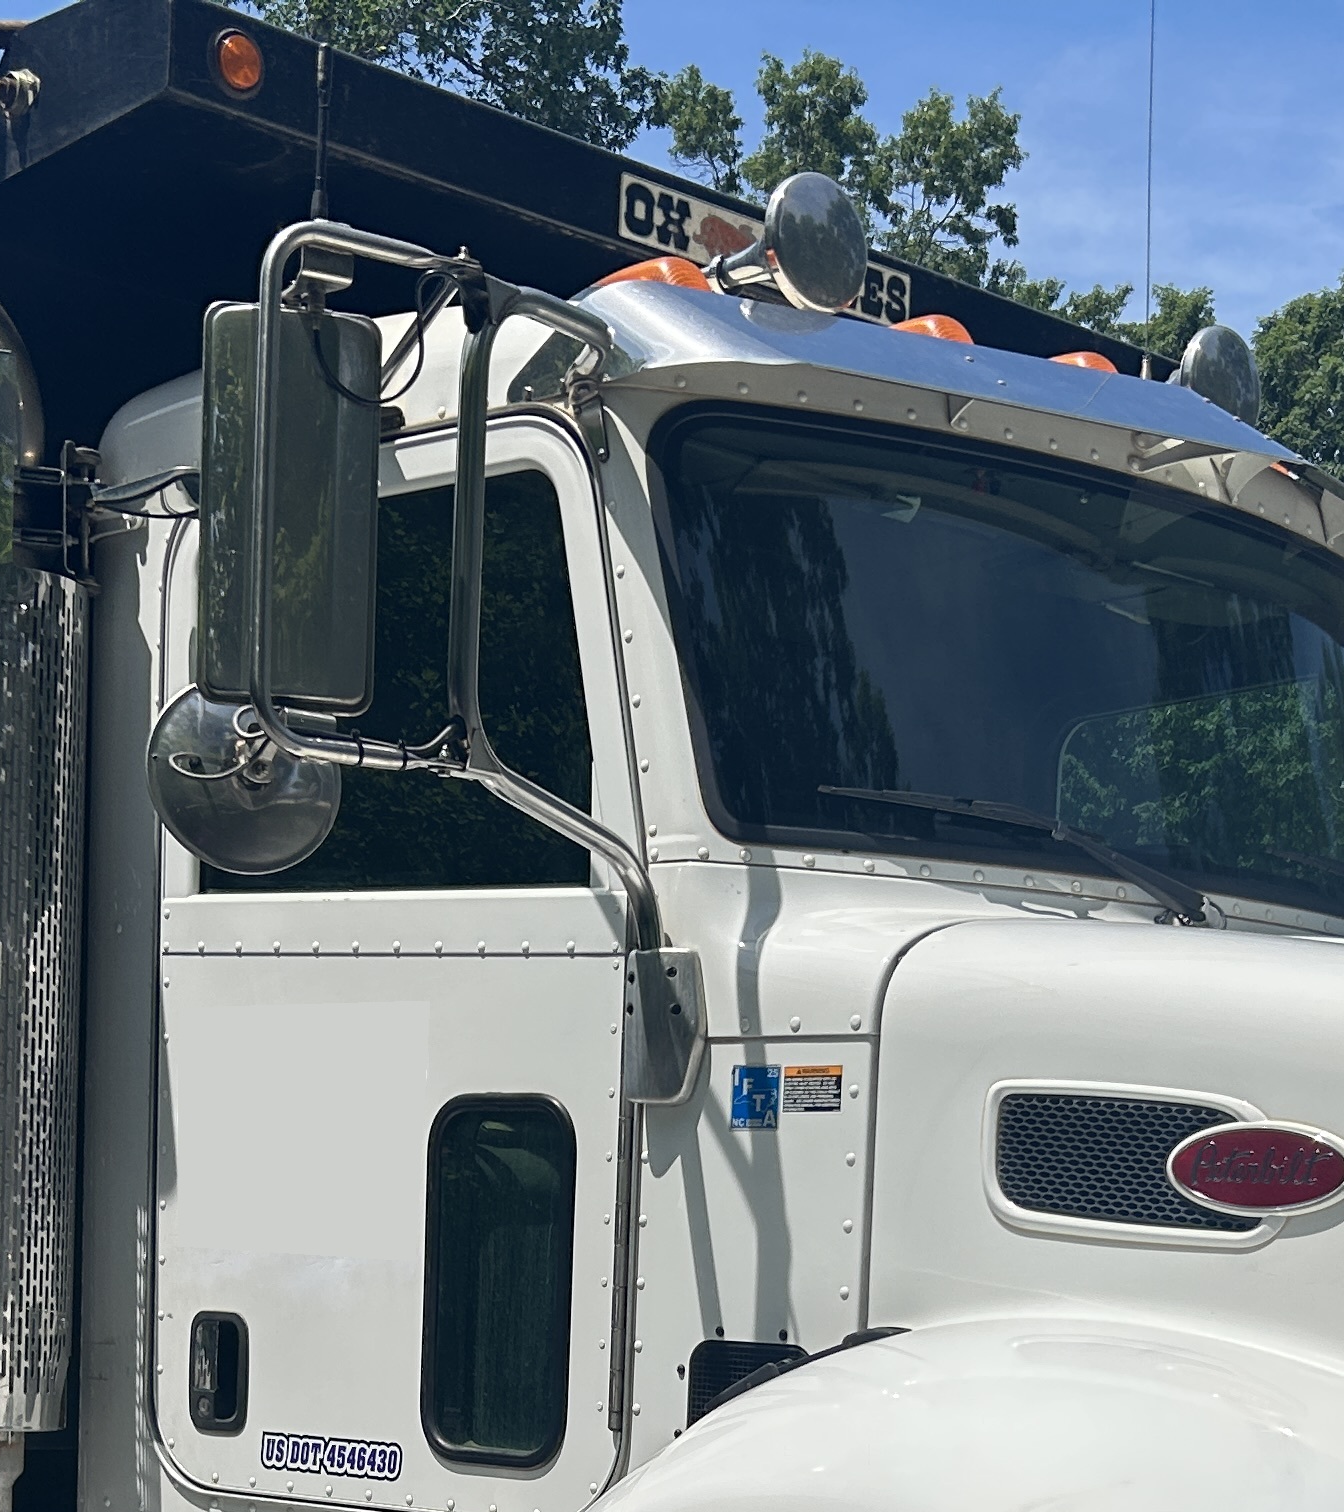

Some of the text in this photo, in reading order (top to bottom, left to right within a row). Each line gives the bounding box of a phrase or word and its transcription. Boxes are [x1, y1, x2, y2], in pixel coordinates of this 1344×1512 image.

[624, 183, 691, 250] OX
[1190, 1140, 1334, 1188] Peterbilt
[265, 1438, 398, 1474] US DOT 4546430
